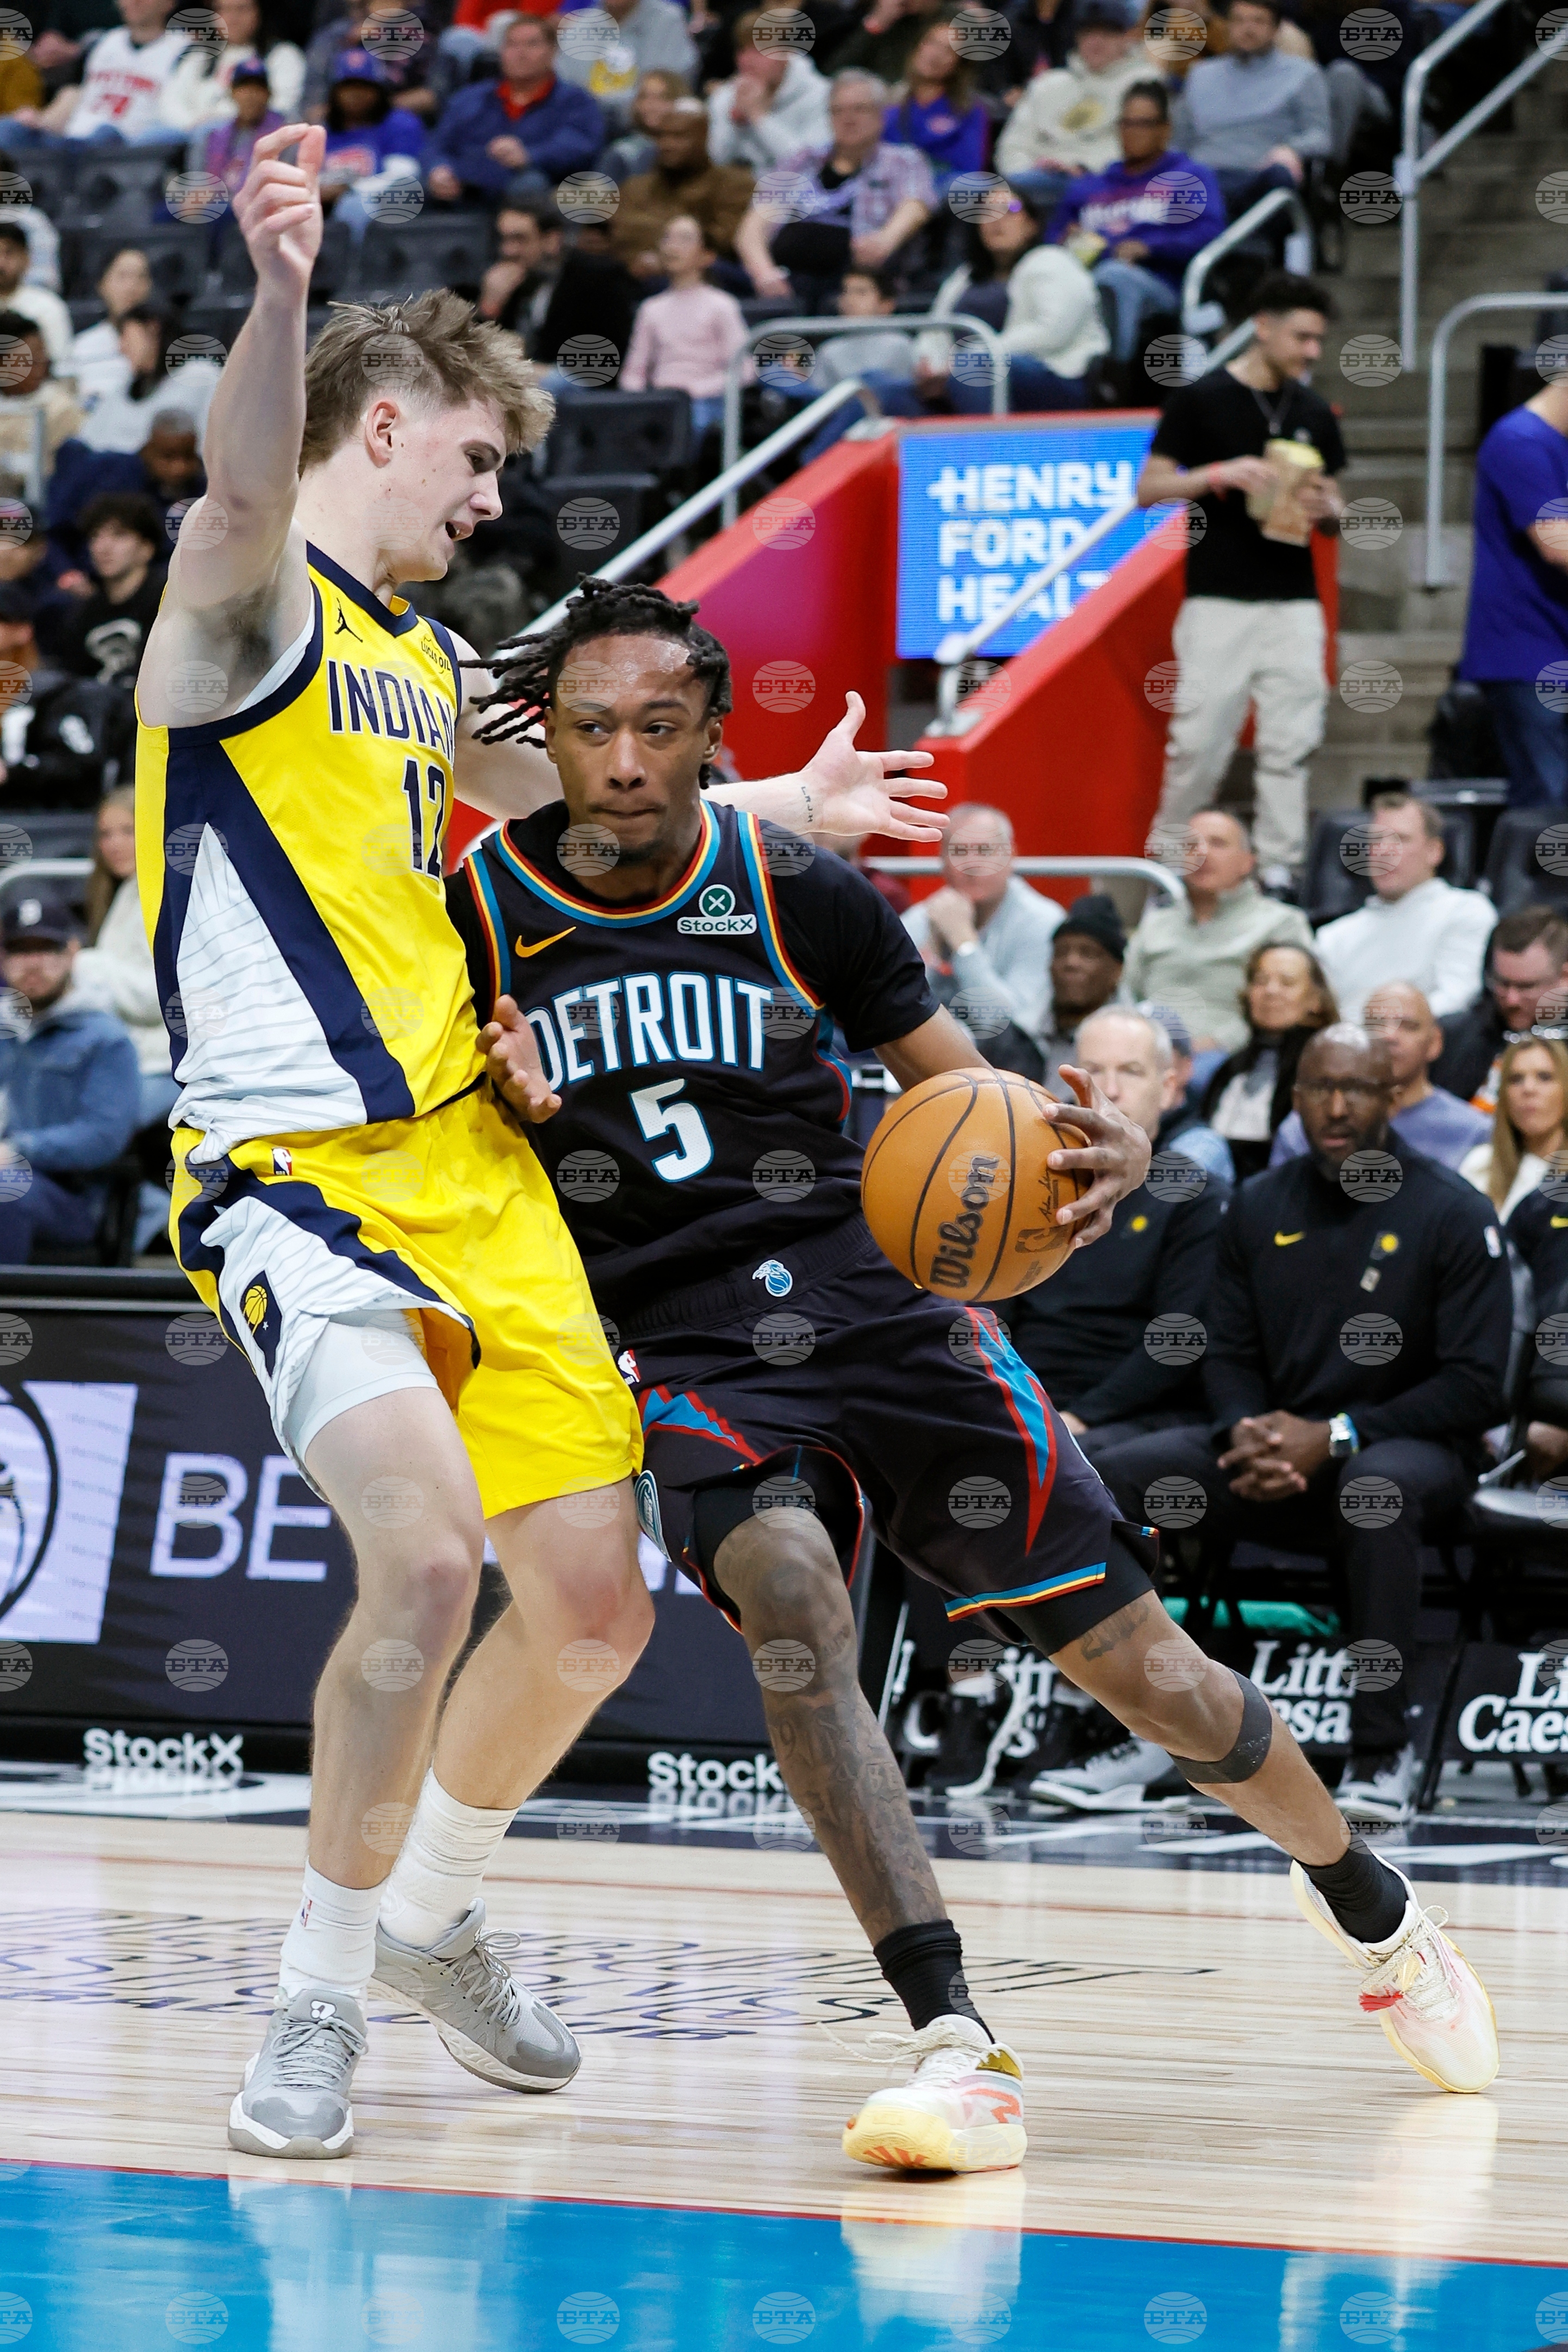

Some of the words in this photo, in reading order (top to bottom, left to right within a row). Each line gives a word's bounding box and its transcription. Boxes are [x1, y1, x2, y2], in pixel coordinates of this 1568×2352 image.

[927, 460, 1133, 512] HENRY
[938, 517, 1088, 568] FORD
[421, 641, 437, 664] LUCAS
[439, 657, 451, 671] OIL
[401, 756, 446, 881] 12
[680, 917, 754, 932] StockX
[525, 972, 773, 1092] DETROIT
[629, 1078, 714, 1183] 5
[929, 1155, 1000, 1289] Wilson
[1250, 1640, 1358, 1698] Litt
[83, 1728, 244, 1772] StockX
[647, 1751, 785, 1793] Stock
